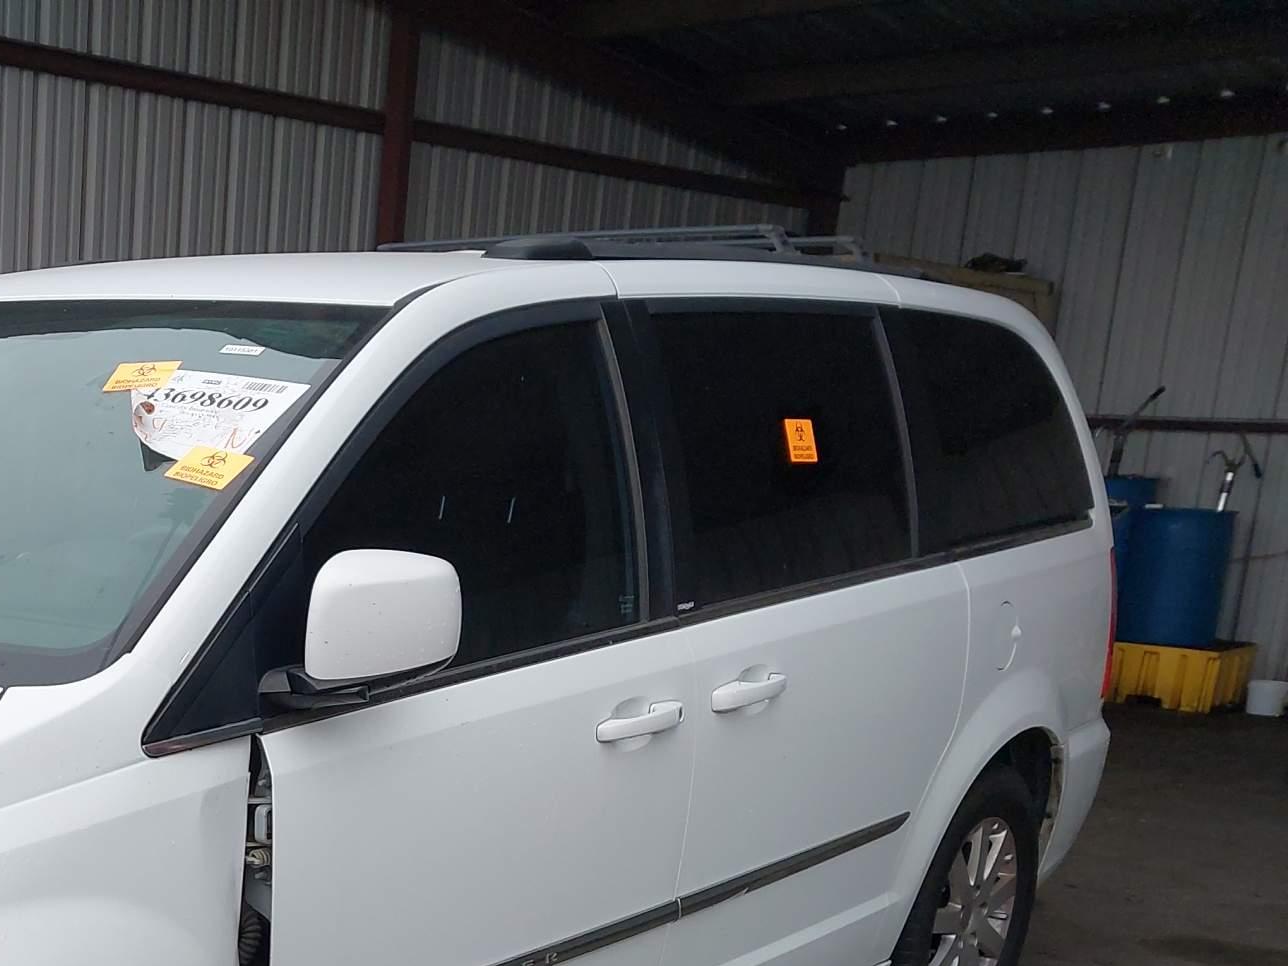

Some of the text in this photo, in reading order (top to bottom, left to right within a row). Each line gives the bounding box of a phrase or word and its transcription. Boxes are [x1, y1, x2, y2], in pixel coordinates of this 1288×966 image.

[143, 387, 269, 412] 43698609
[173, 471, 218, 486] BIOPELIGRO
[180, 465, 225, 480] BIOHAZARD
